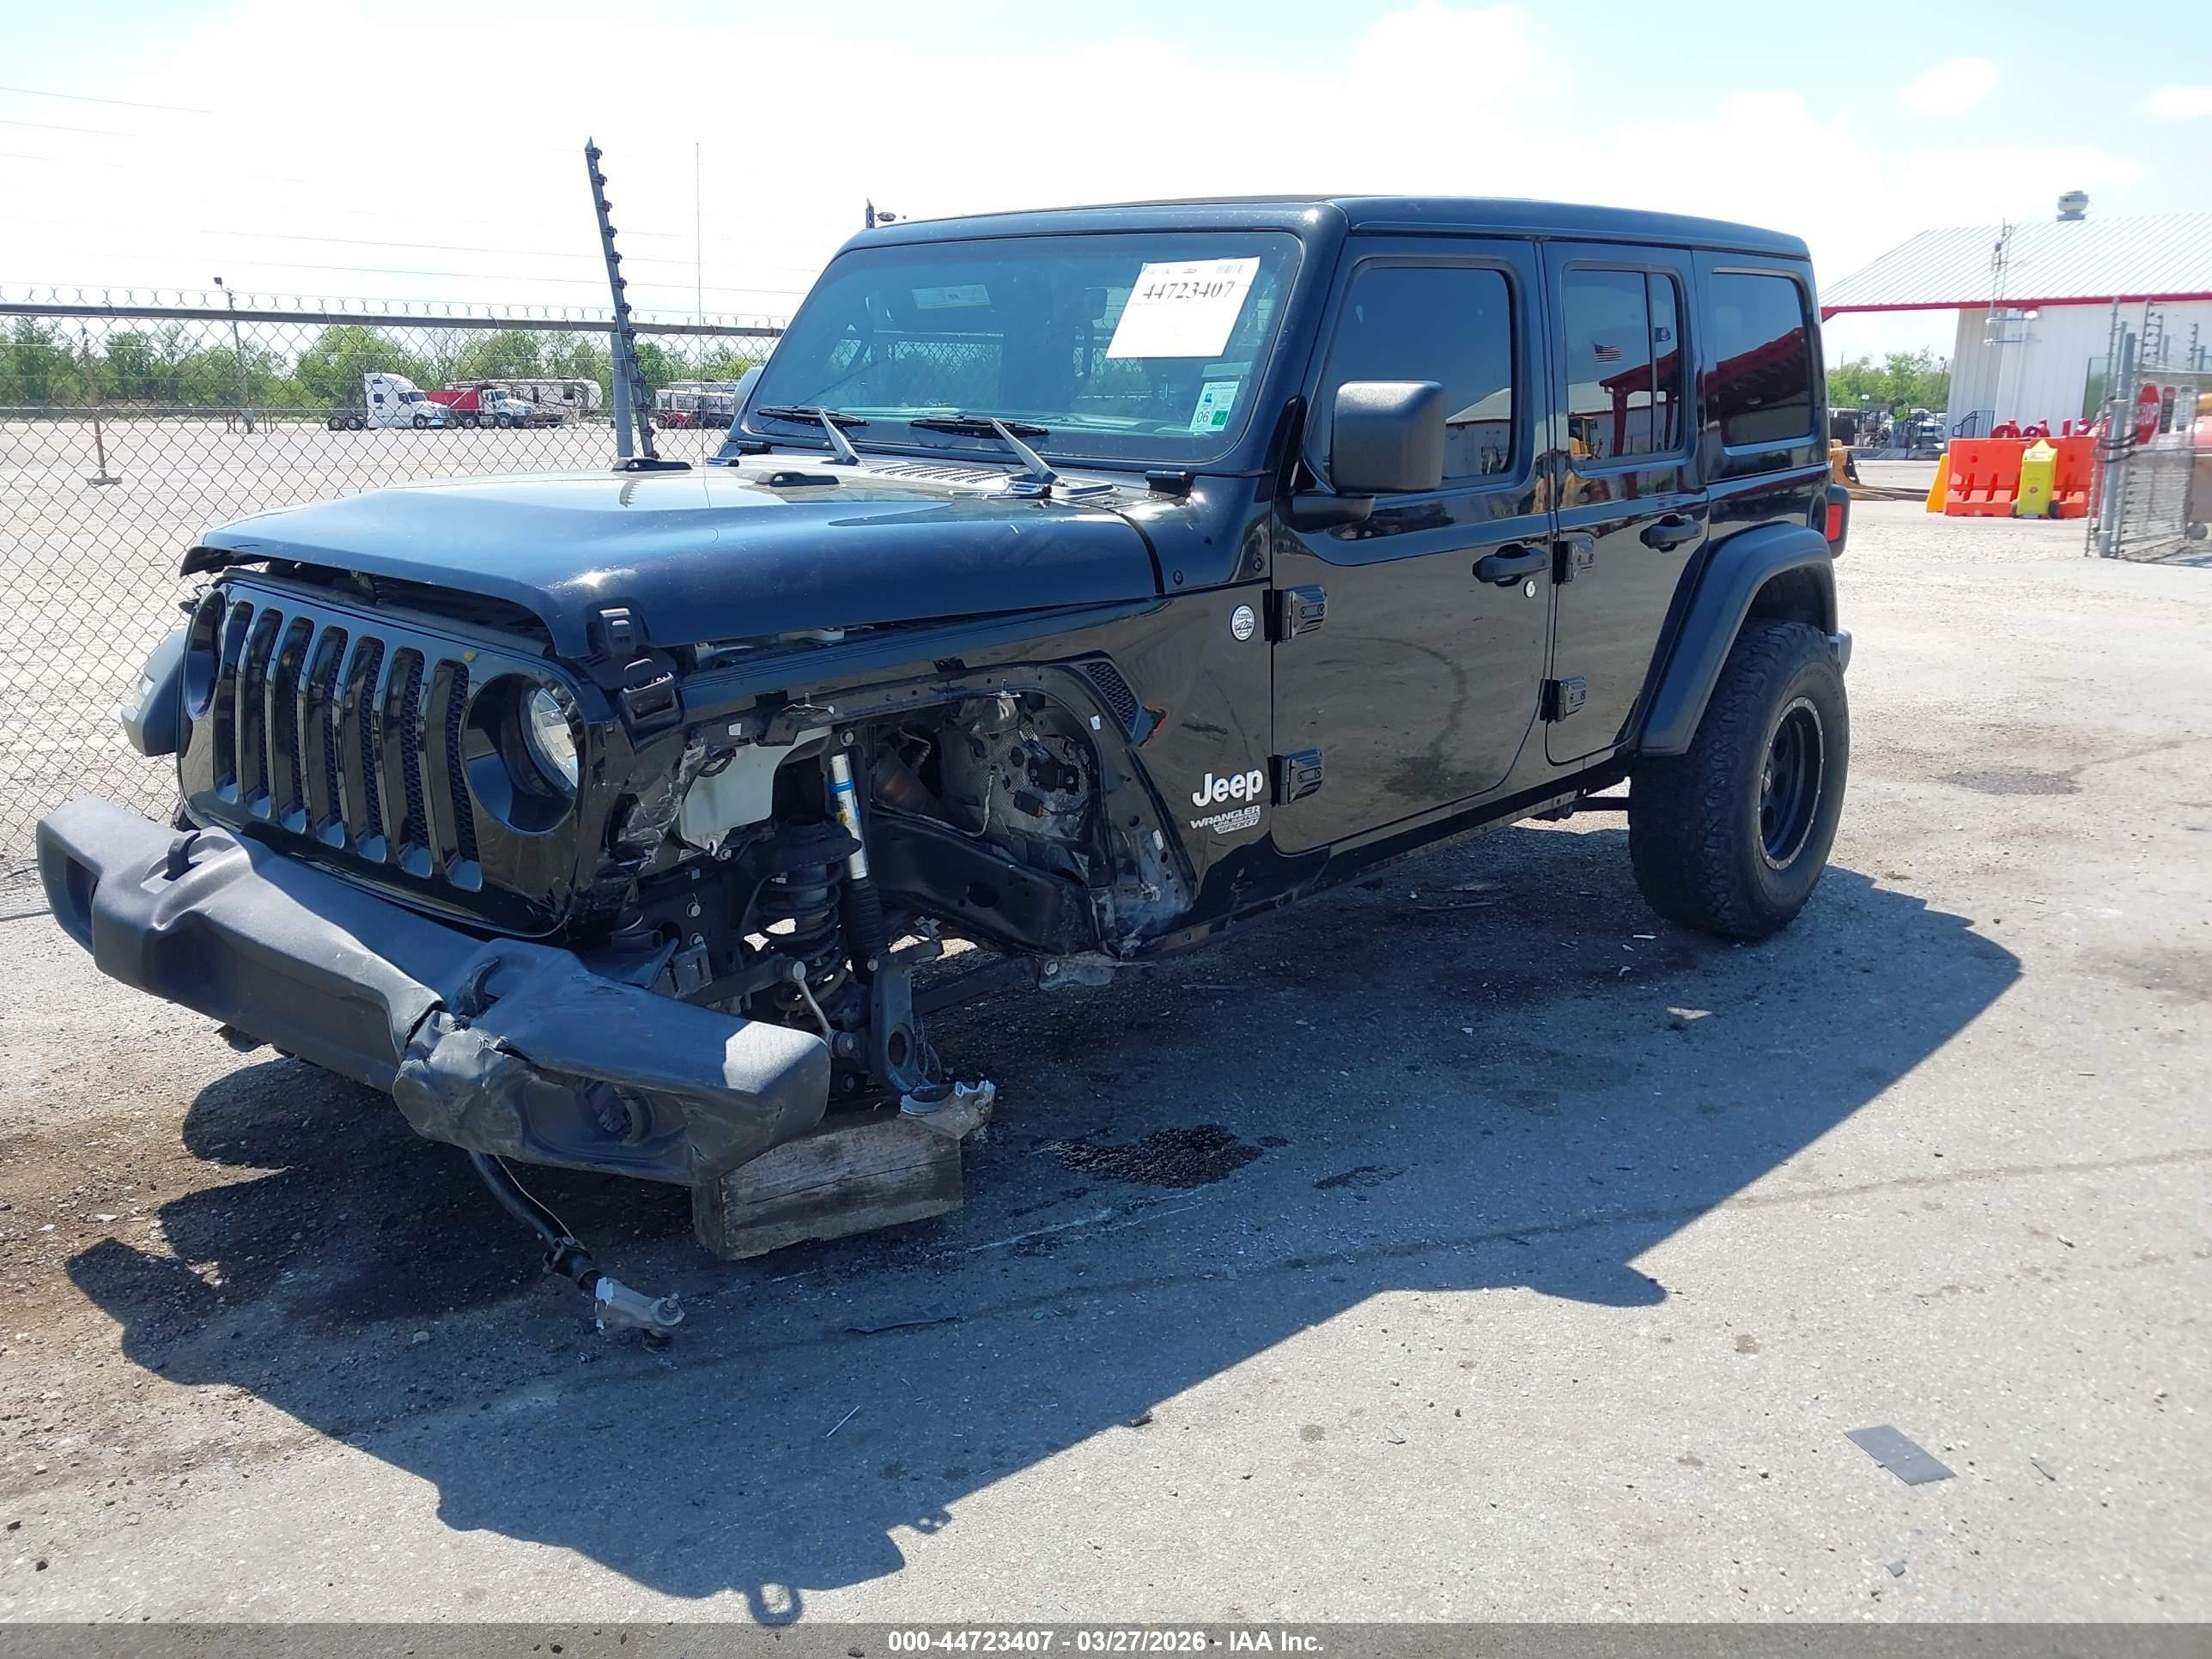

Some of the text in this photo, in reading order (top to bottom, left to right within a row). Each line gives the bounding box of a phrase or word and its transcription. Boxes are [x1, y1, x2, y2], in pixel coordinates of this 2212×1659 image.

[1142, 280, 1236, 301] 44723407
[1196, 410, 1210, 423] 06
[2135, 402, 2159, 426] STOP
[1192, 769, 1263, 807] Jeep
[1190, 805, 1261, 830] WRANGLER
[1213, 812, 1261, 827] UNLIMITED
